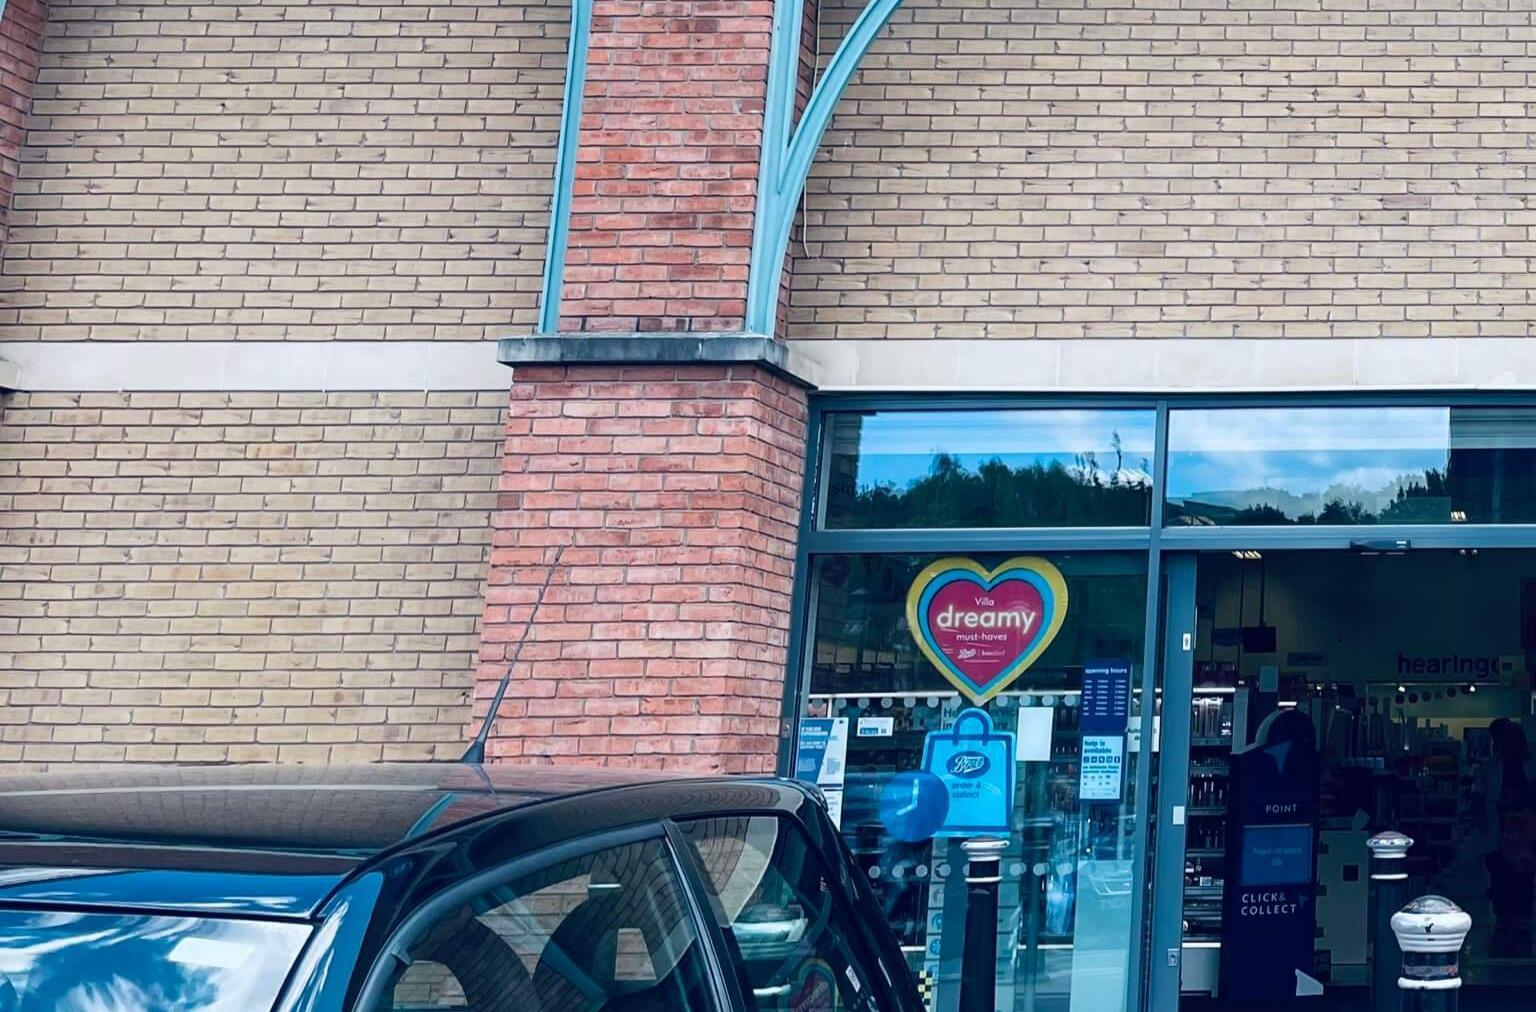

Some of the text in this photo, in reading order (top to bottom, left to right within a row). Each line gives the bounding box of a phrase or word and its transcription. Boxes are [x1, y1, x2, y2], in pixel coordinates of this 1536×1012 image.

[974, 597, 994, 606] Villa
[936, 604, 1036, 635] dreamy
[956, 632, 1008, 641] must-haves
[1265, 804, 1298, 813] POINT
[1241, 904, 1297, 916] COLLECT
